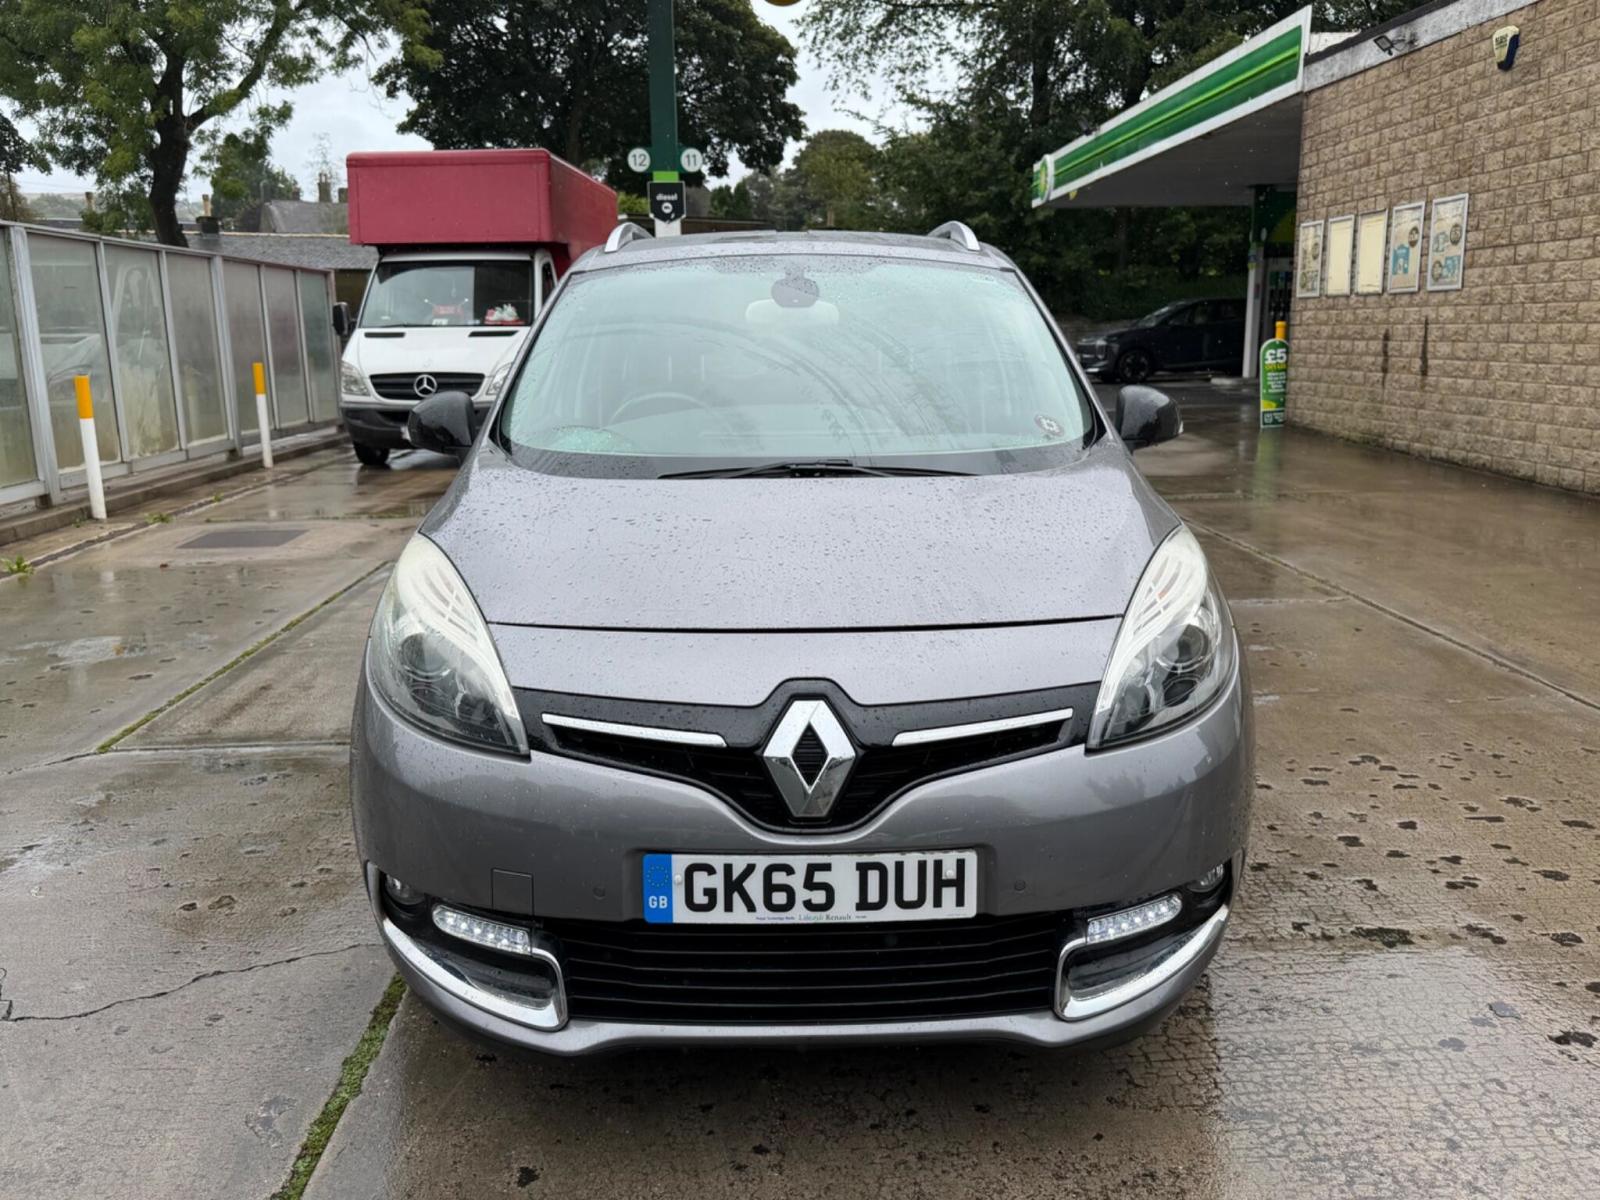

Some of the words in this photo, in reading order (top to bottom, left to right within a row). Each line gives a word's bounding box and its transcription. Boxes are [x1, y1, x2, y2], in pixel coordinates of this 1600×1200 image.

[631, 153, 647, 167] 12
[685, 153, 698, 167] 11
[1264, 348, 1287, 364] £5
[684, 862, 836, 913] GK65
[855, 858, 966, 911] DUH
[648, 895, 668, 909] GB
[825, 913, 852, 921] Renault
